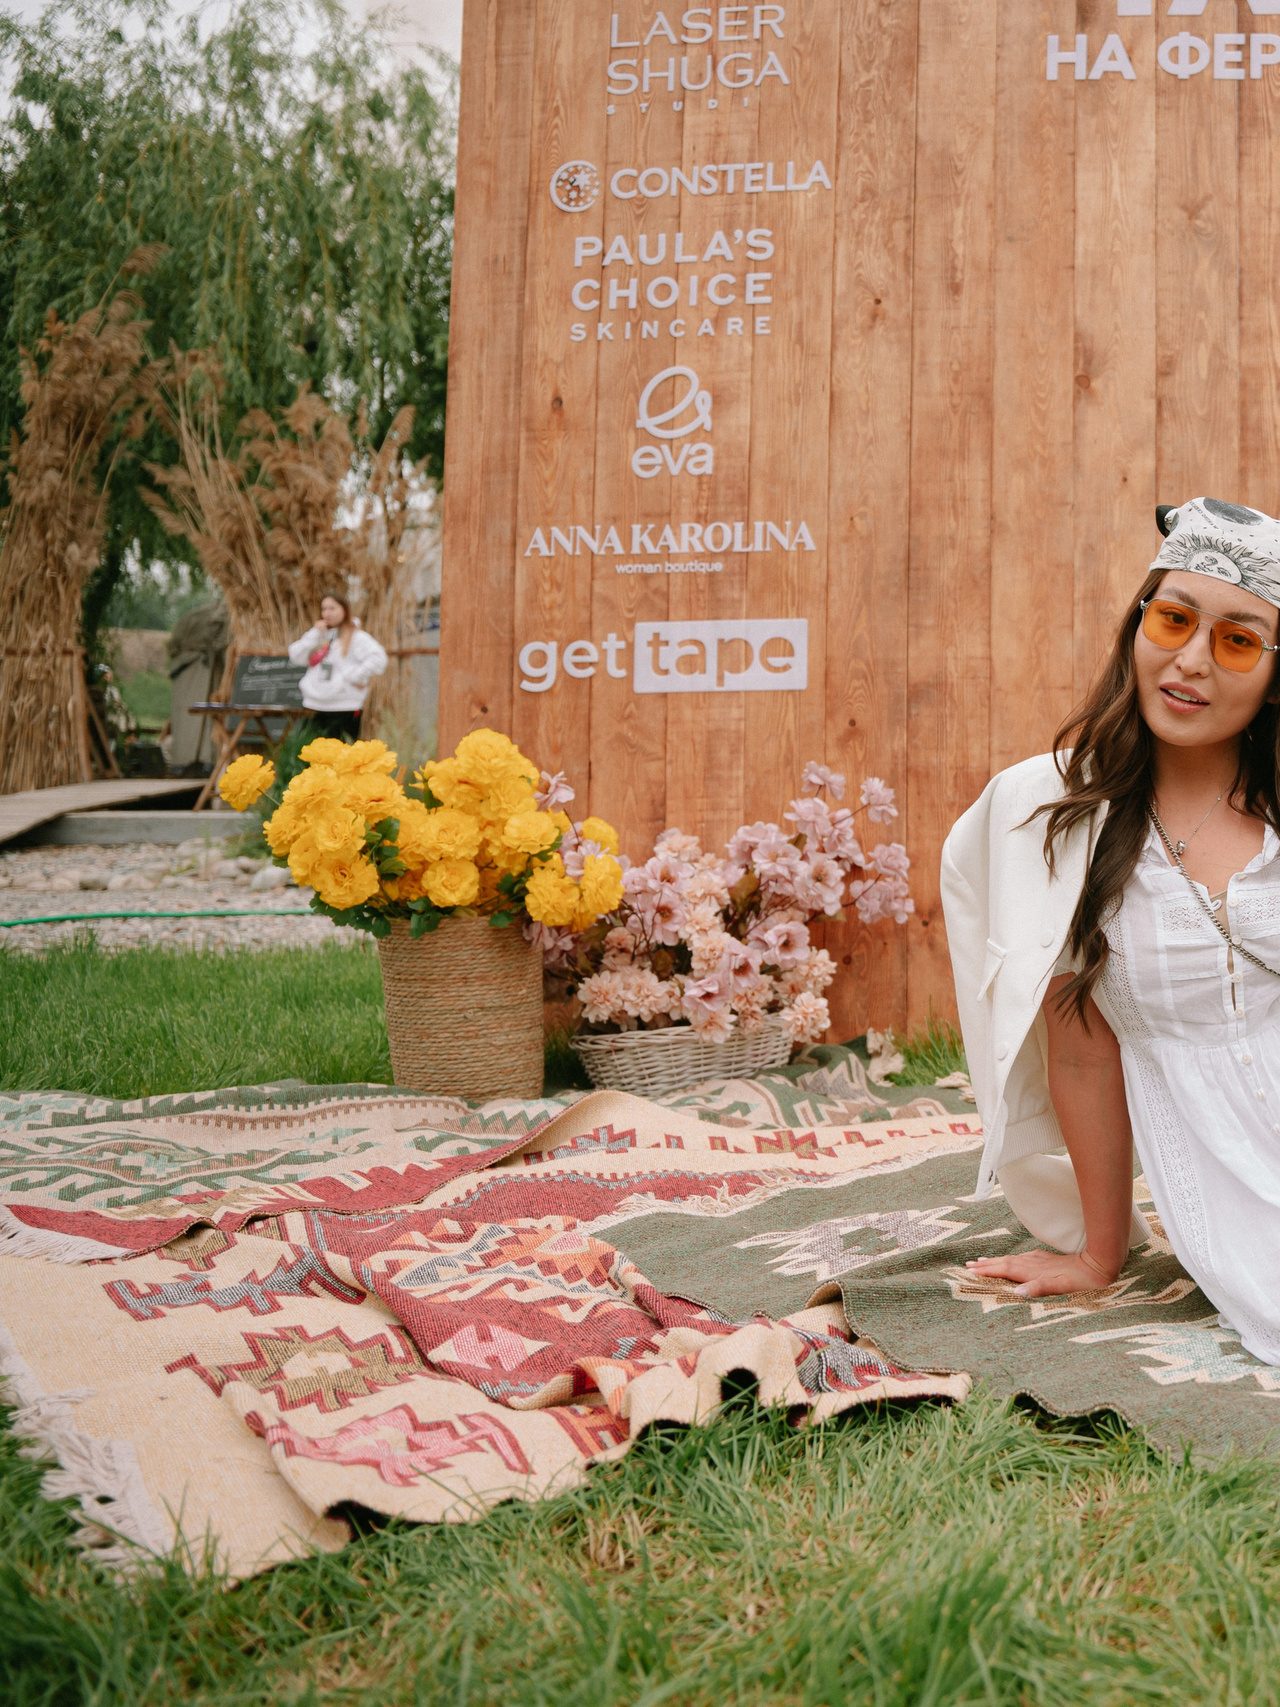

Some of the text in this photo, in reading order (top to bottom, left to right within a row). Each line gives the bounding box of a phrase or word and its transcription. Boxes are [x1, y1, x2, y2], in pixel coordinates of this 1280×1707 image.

[610, 4, 786, 48] LASER
[606, 51, 790, 95] SHUGA
[1046, 33, 1137, 81] НА
[610, 160, 832, 199] CONSTELLA
[574, 228, 775, 267] PAULA'S
[571, 272, 773, 312] CHOICE
[570, 316, 772, 342] SKINCARE
[631, 442, 714, 479] eva
[524, 520, 817, 557] ANNA KAROLINA
[664, 560, 723, 575] boutique
